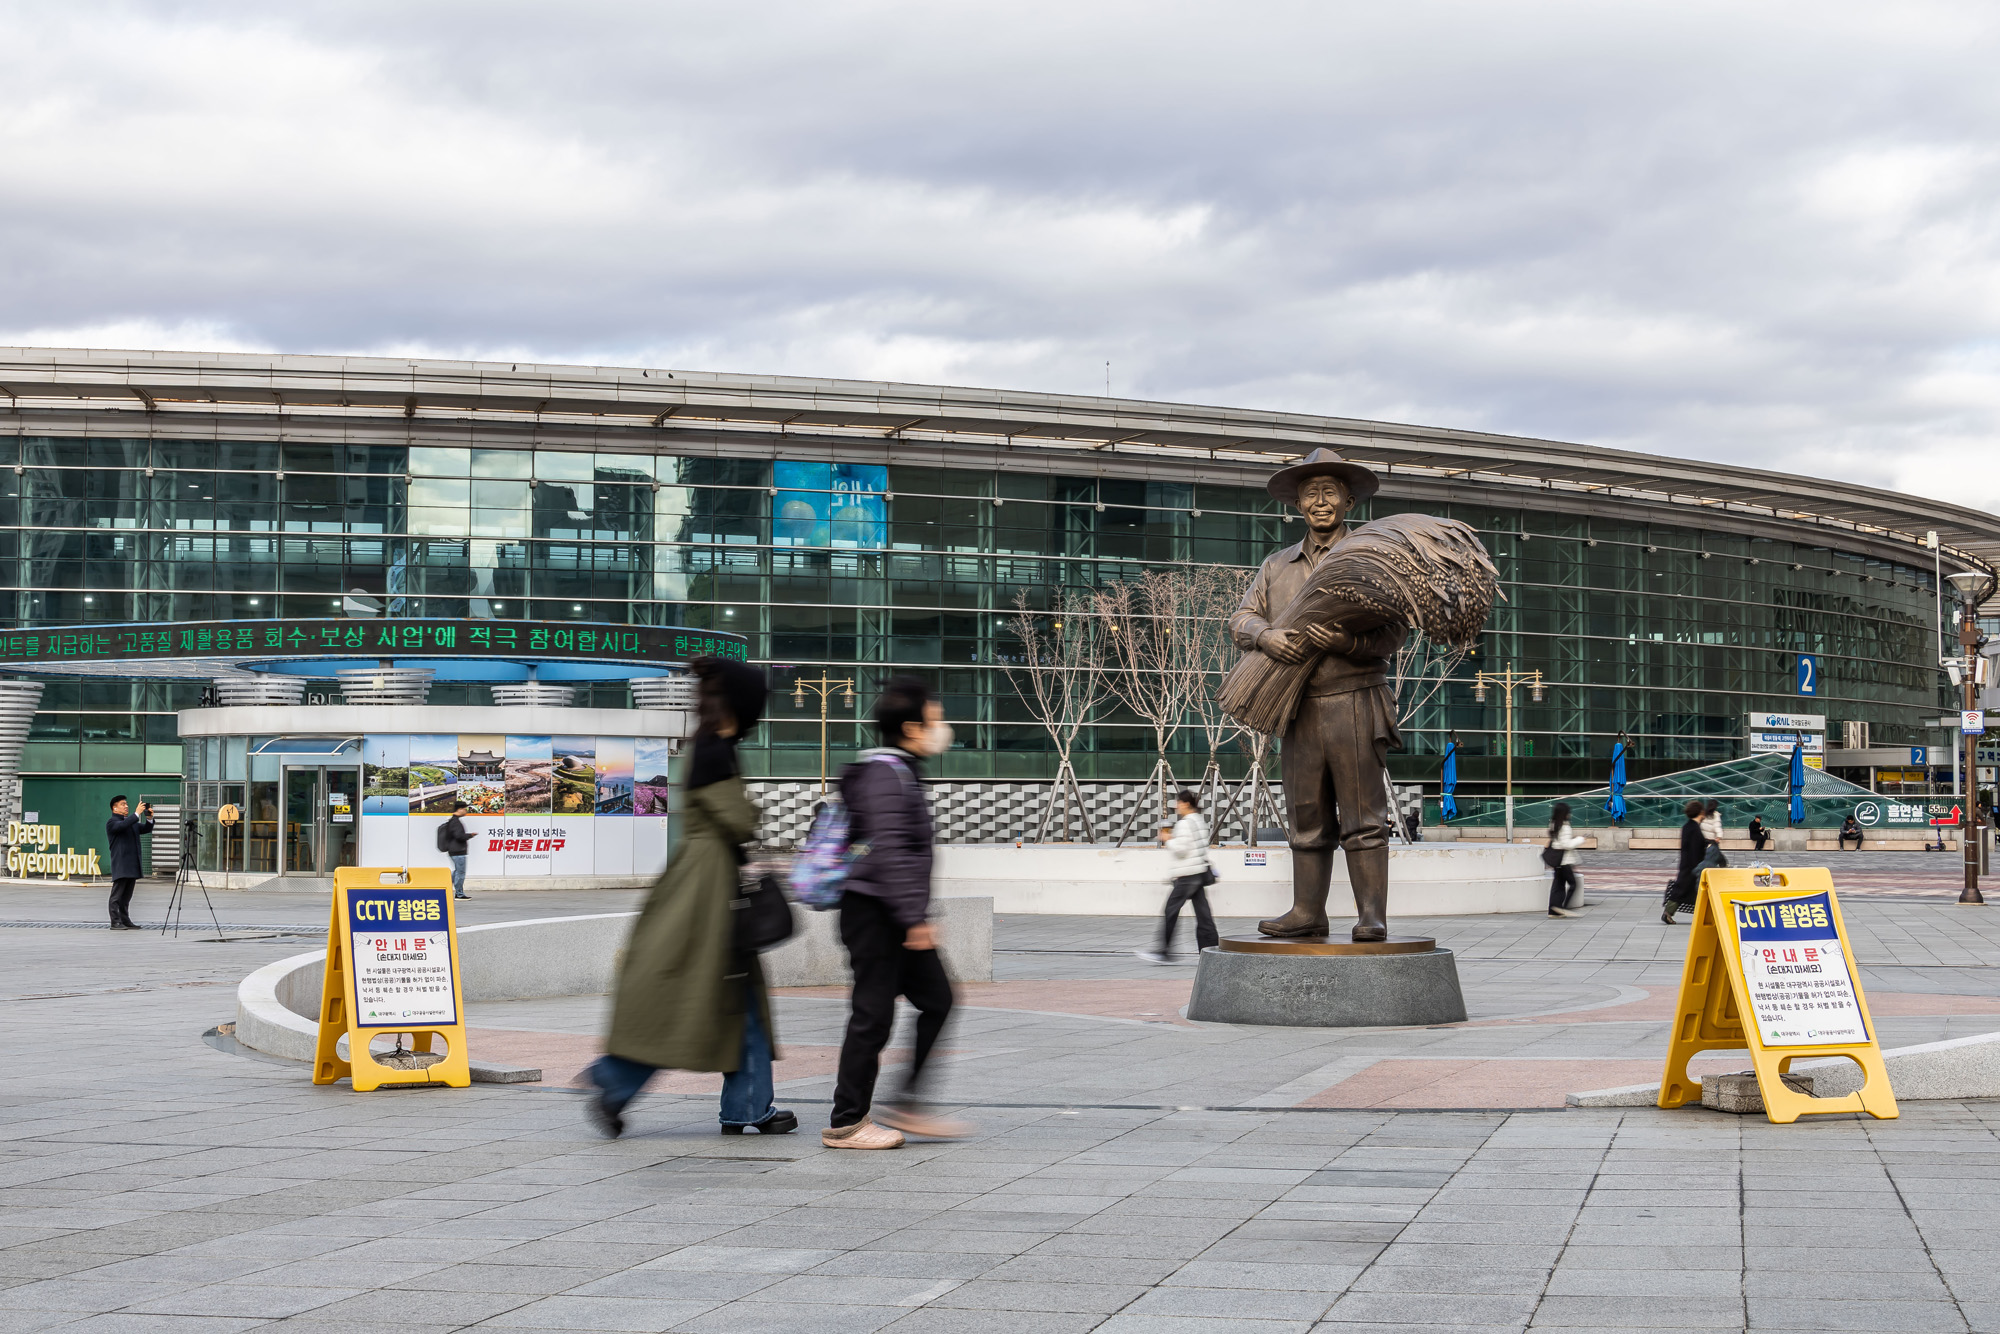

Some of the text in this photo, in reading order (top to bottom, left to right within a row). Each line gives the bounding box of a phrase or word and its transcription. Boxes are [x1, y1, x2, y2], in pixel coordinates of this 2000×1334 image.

[46, 634, 111, 655] 지급하는
[180, 628, 254, 651] 재활용품
[469, 627, 517, 649] 적극
[529, 629, 647, 653] 참여합시다.
[1801, 658, 1813, 692] 2
[1766, 715, 1790, 726] KORAIL
[1914, 749, 1923, 763] 2
[1888, 804, 1949, 818] 흡연실 55m
[8, 821, 60, 851] Daegu
[516, 828, 540, 837] 활력이
[542, 828, 567, 837] 넘치는
[488, 839, 566, 852] 파워풀 대구
[7, 847, 101, 880] Gyeongbuk
[355, 899, 441, 921] CCTV 촬영중
[1739, 903, 1829, 928] CCTV 촬영중
[392, 967, 417, 975] 대구광역시
[1786, 980, 1814, 989] 대구광역시
